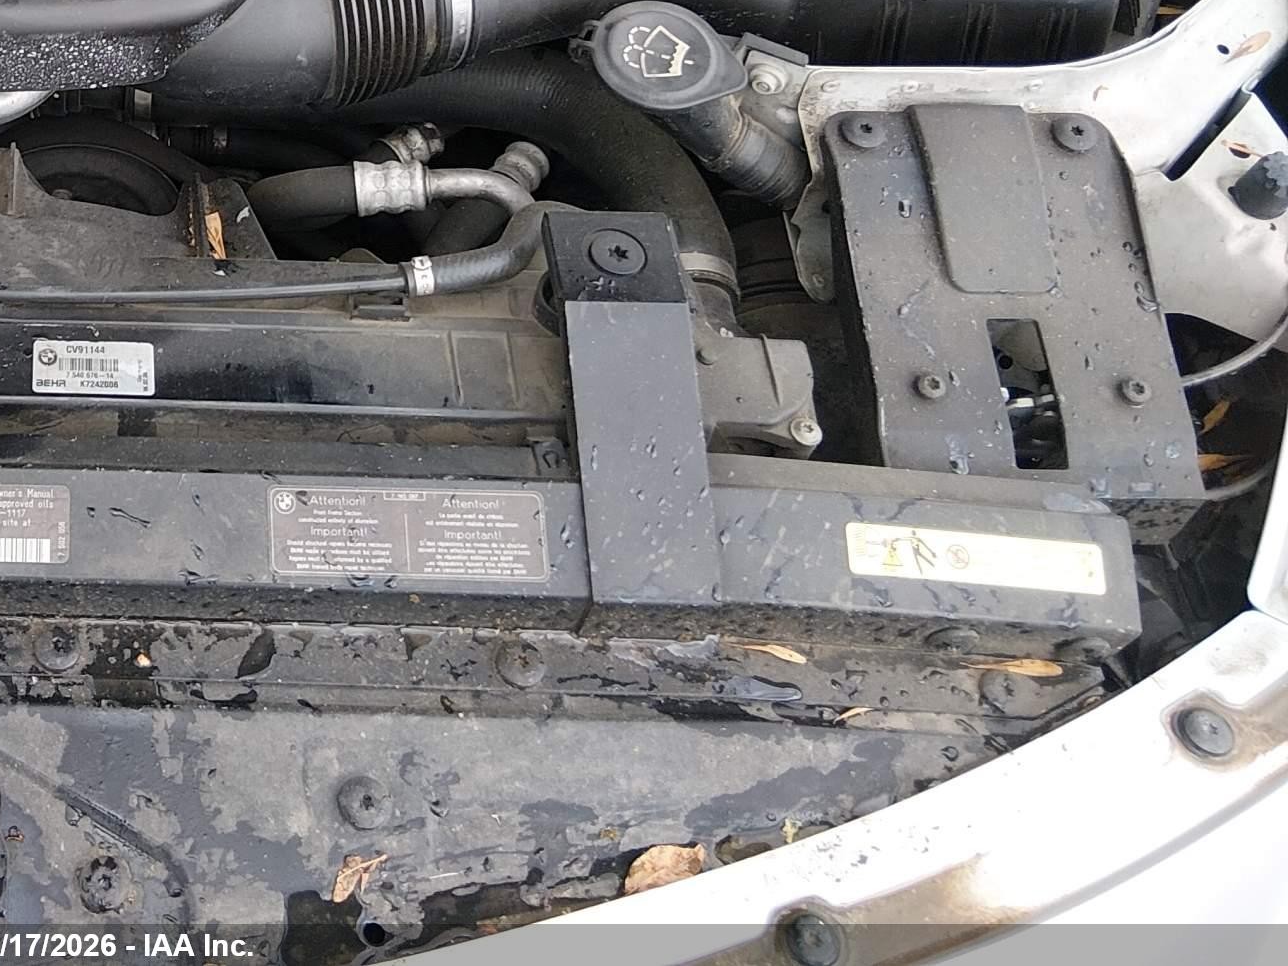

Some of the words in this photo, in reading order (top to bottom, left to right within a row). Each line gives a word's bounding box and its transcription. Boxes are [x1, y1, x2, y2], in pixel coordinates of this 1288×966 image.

[66, 346, 105, 354] CV91144
[36, 379, 66, 387] BEHR
[38, 499, 54, 508] oils
[309, 495, 366, 507] Attention!
[442, 498, 499, 510] Attention!
[2, 519, 18, 527] site
[22, 519, 32, 527] at
[311, 526, 368, 537] Important!
[444, 529, 502, 540] Important!
